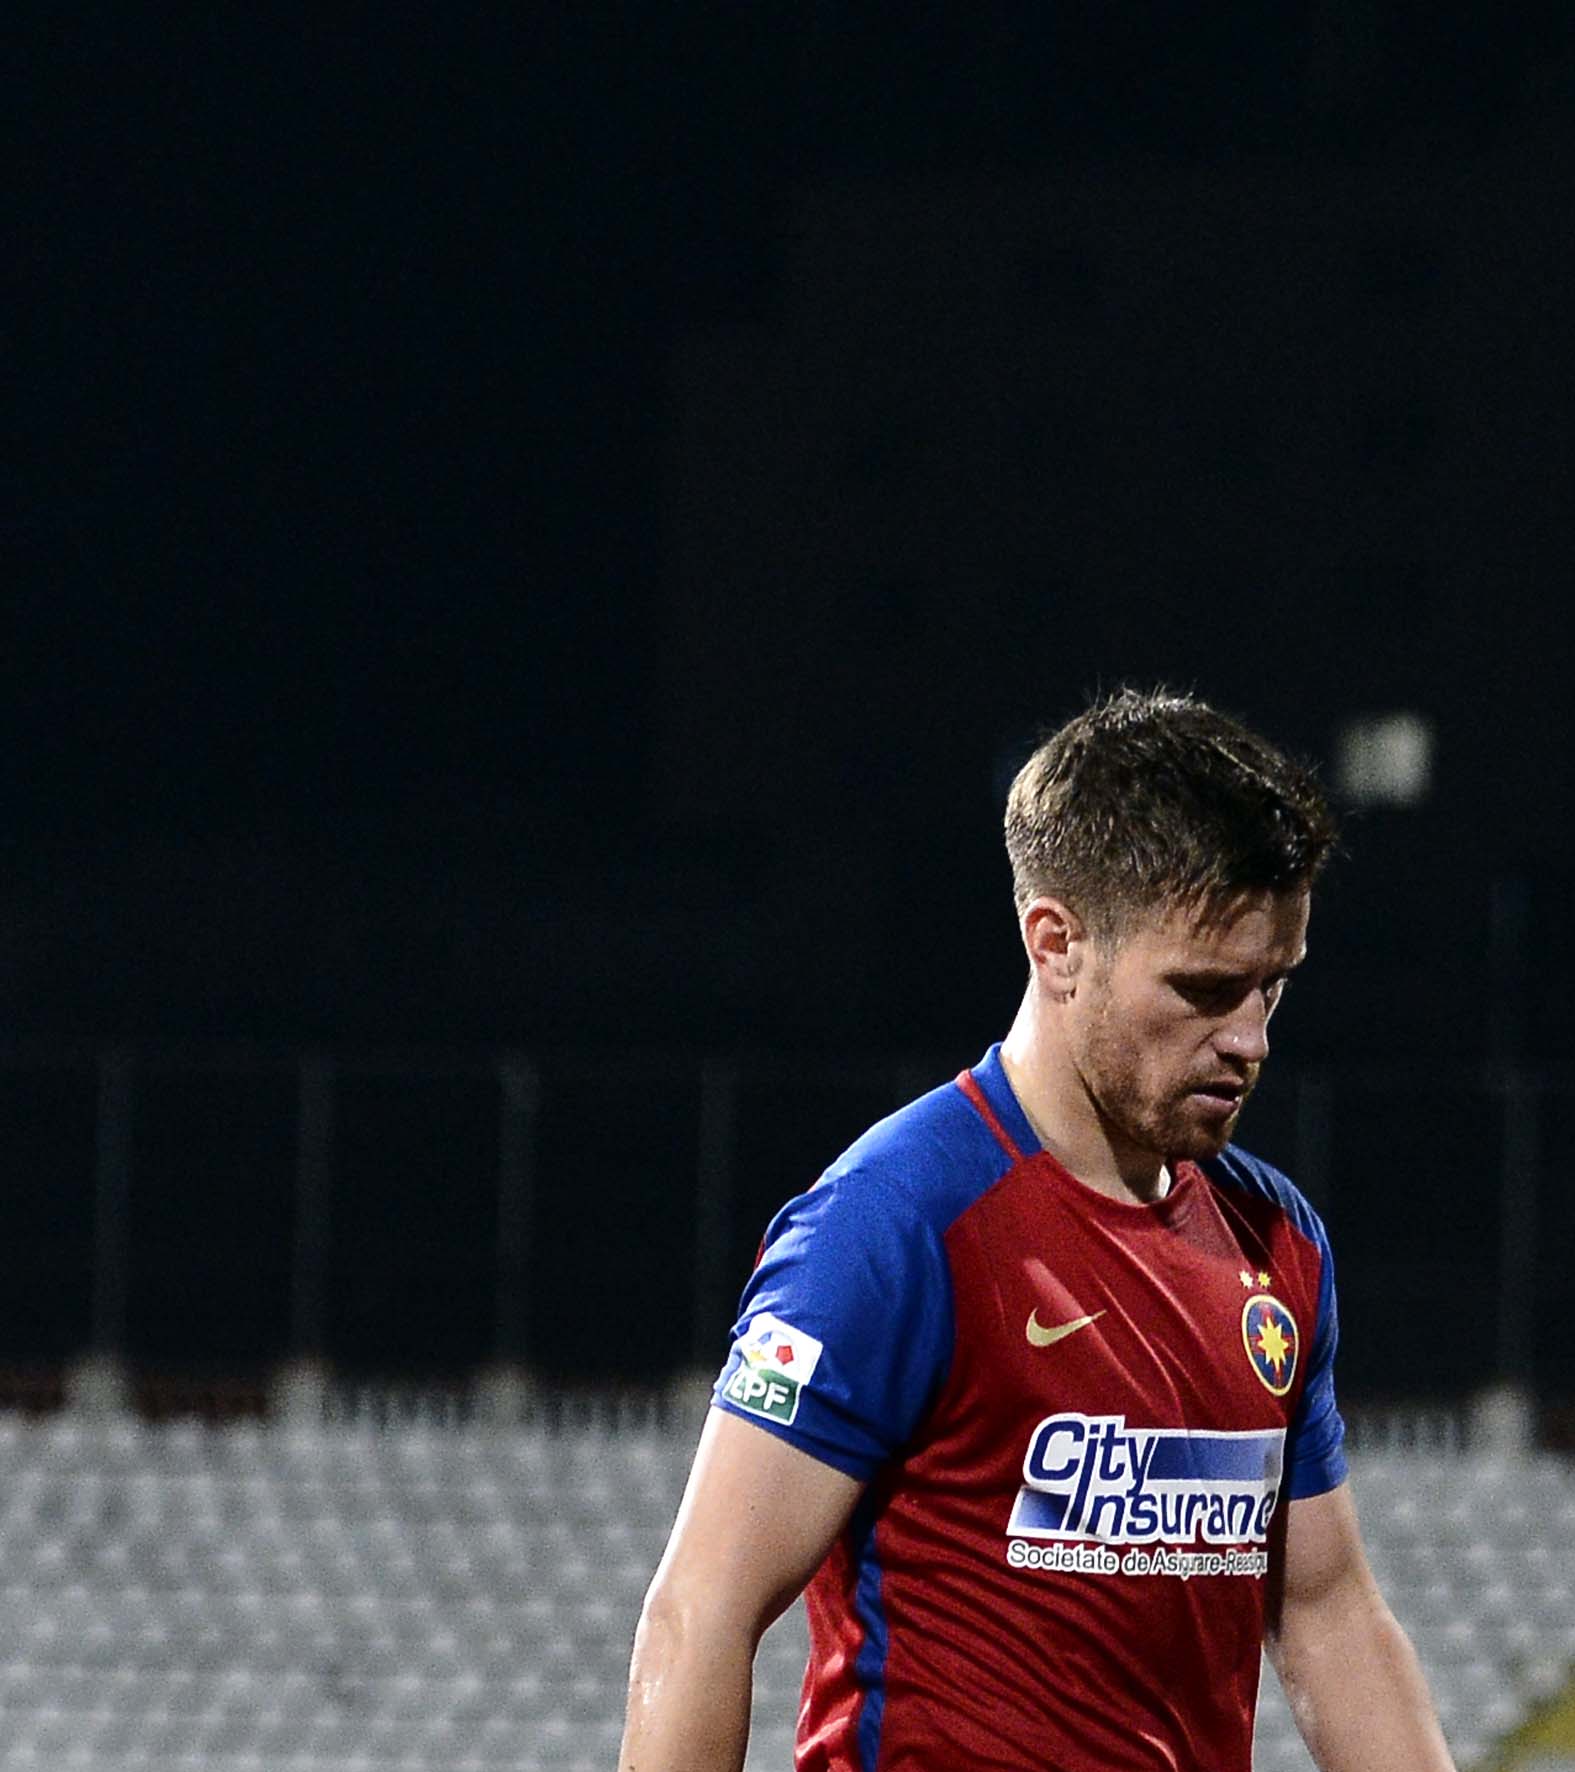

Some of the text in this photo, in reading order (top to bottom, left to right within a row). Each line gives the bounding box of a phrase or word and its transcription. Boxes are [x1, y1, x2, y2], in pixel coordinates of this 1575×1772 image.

[729, 1367, 790, 1411] LPF
[1028, 1419, 1157, 1500] City
[1009, 1542, 1118, 1572] Societate
[1124, 1549, 1149, 1573] de
